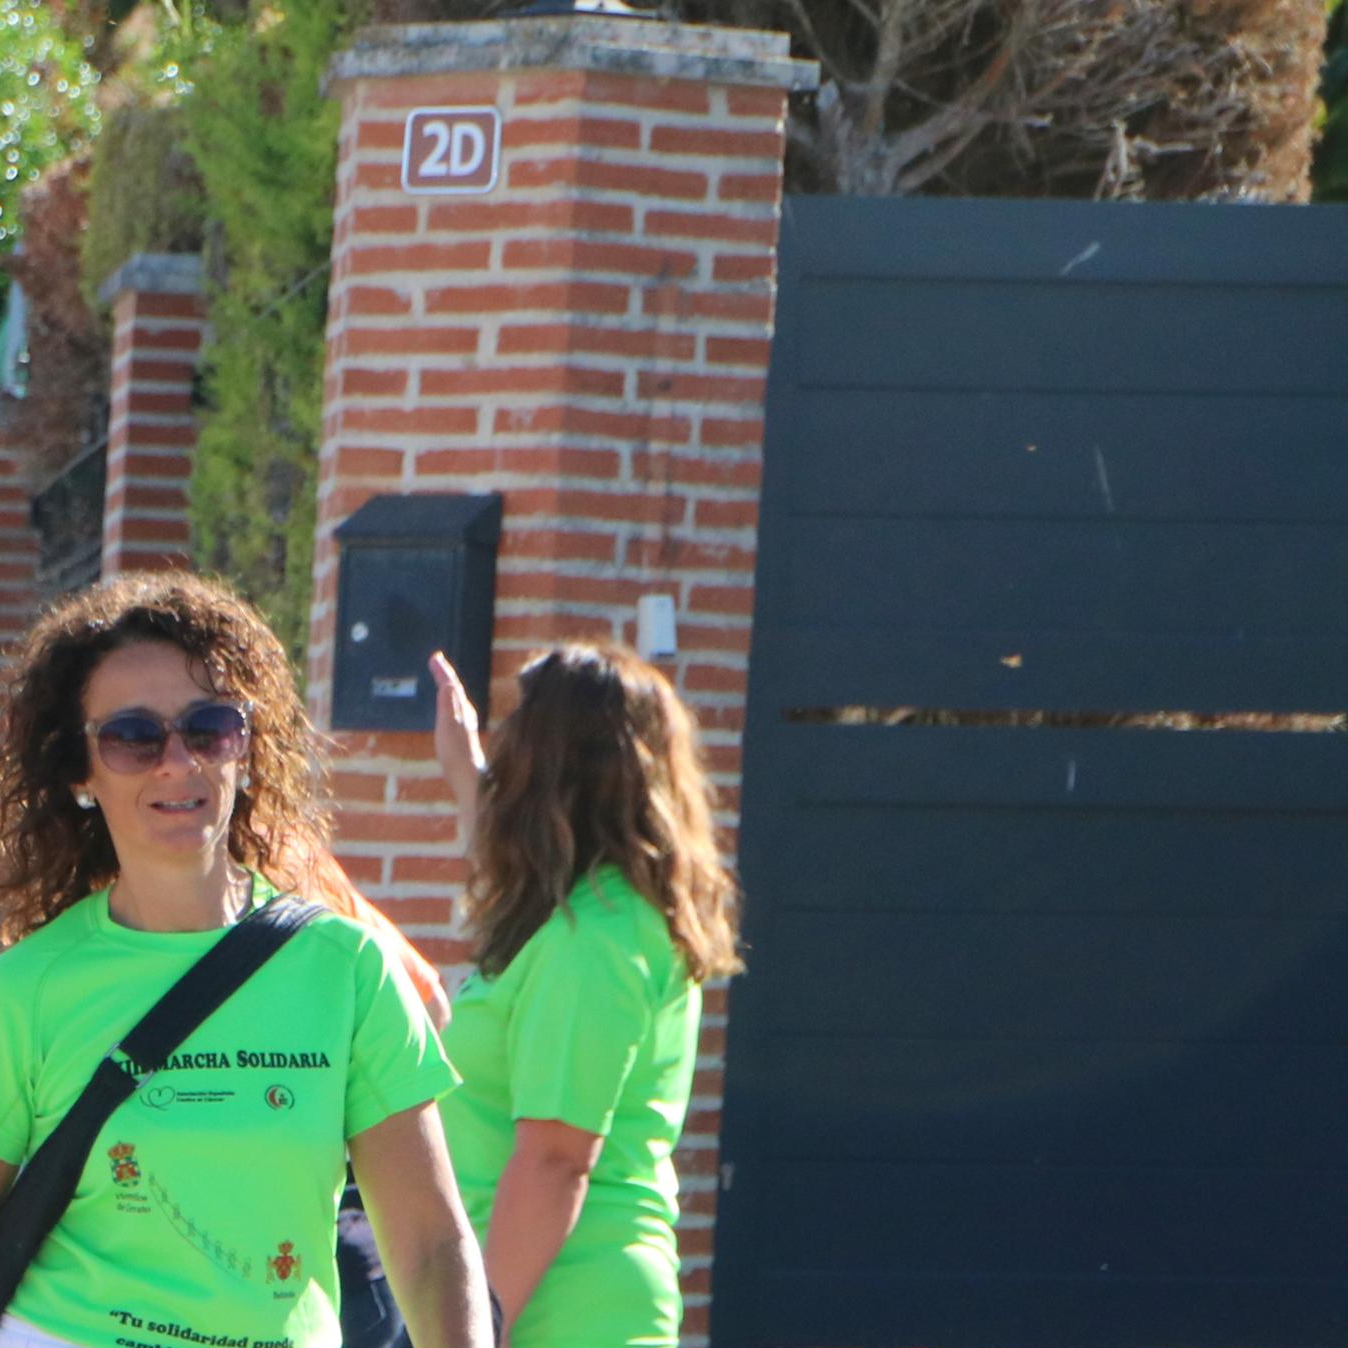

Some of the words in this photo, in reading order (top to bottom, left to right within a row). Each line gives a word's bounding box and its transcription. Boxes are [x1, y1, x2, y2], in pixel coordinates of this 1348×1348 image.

[417, 120, 486, 177] 2D
[236, 1050, 331, 1069] SOLIDARIA
[147, 1320, 249, 1348] solidaridad
